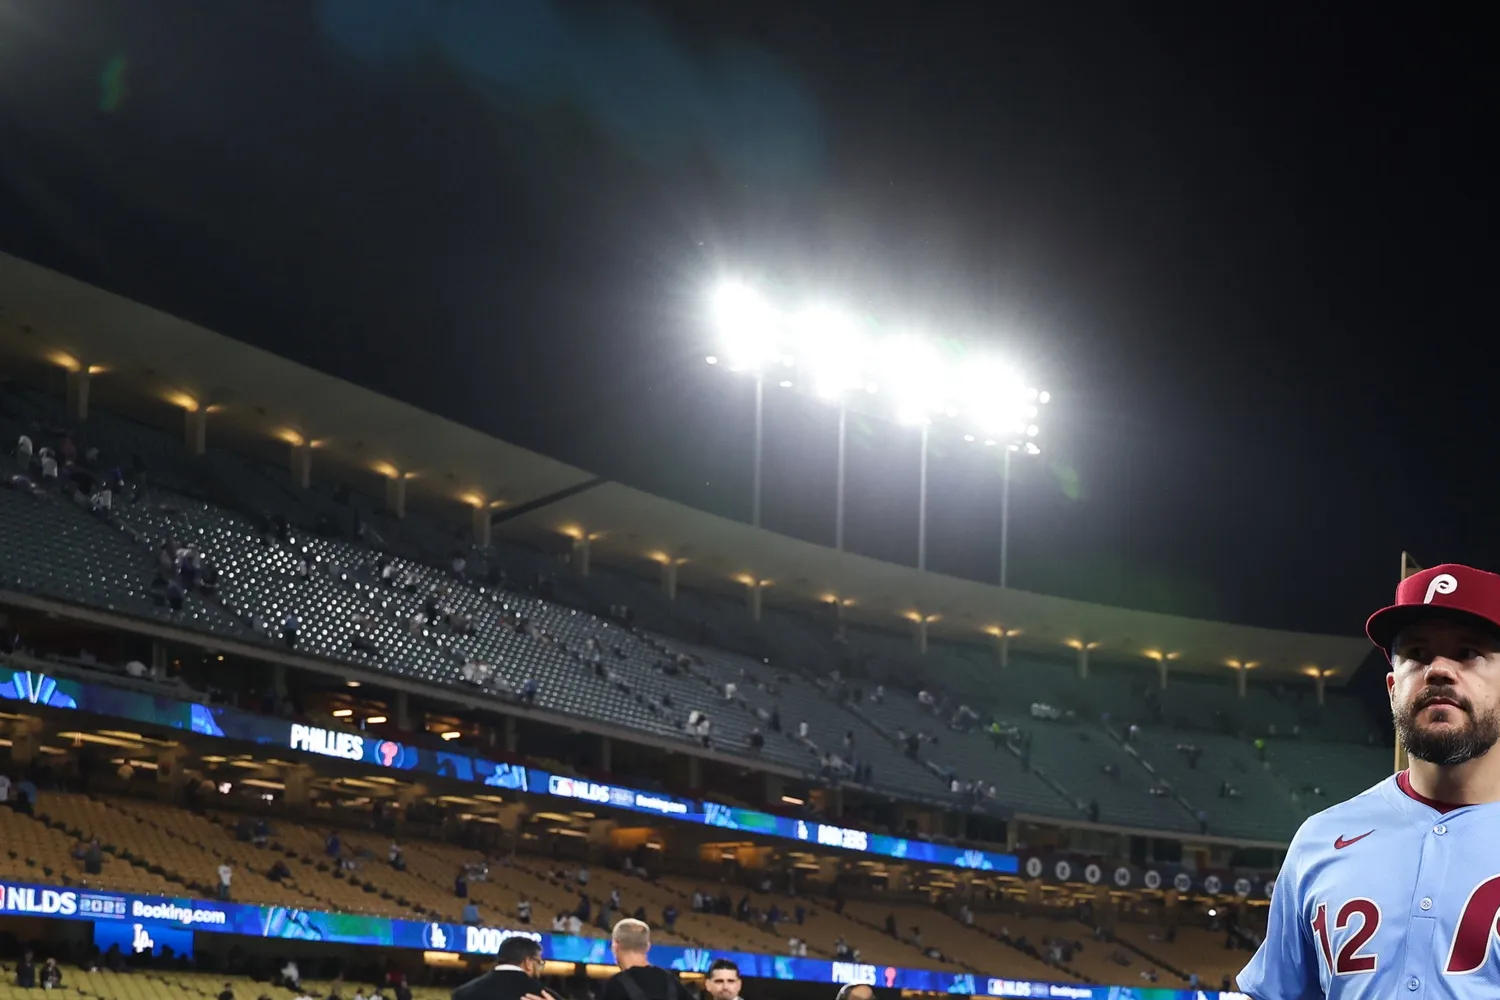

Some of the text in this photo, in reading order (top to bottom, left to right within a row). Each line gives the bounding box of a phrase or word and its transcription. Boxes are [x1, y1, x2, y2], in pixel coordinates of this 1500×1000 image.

[1423, 573, 1458, 605] P
[290, 723, 364, 760] PHILLIES
[8, 886, 77, 915] NLDS
[132, 901, 226, 924] Booking.com
[1311, 897, 1382, 976] 12
